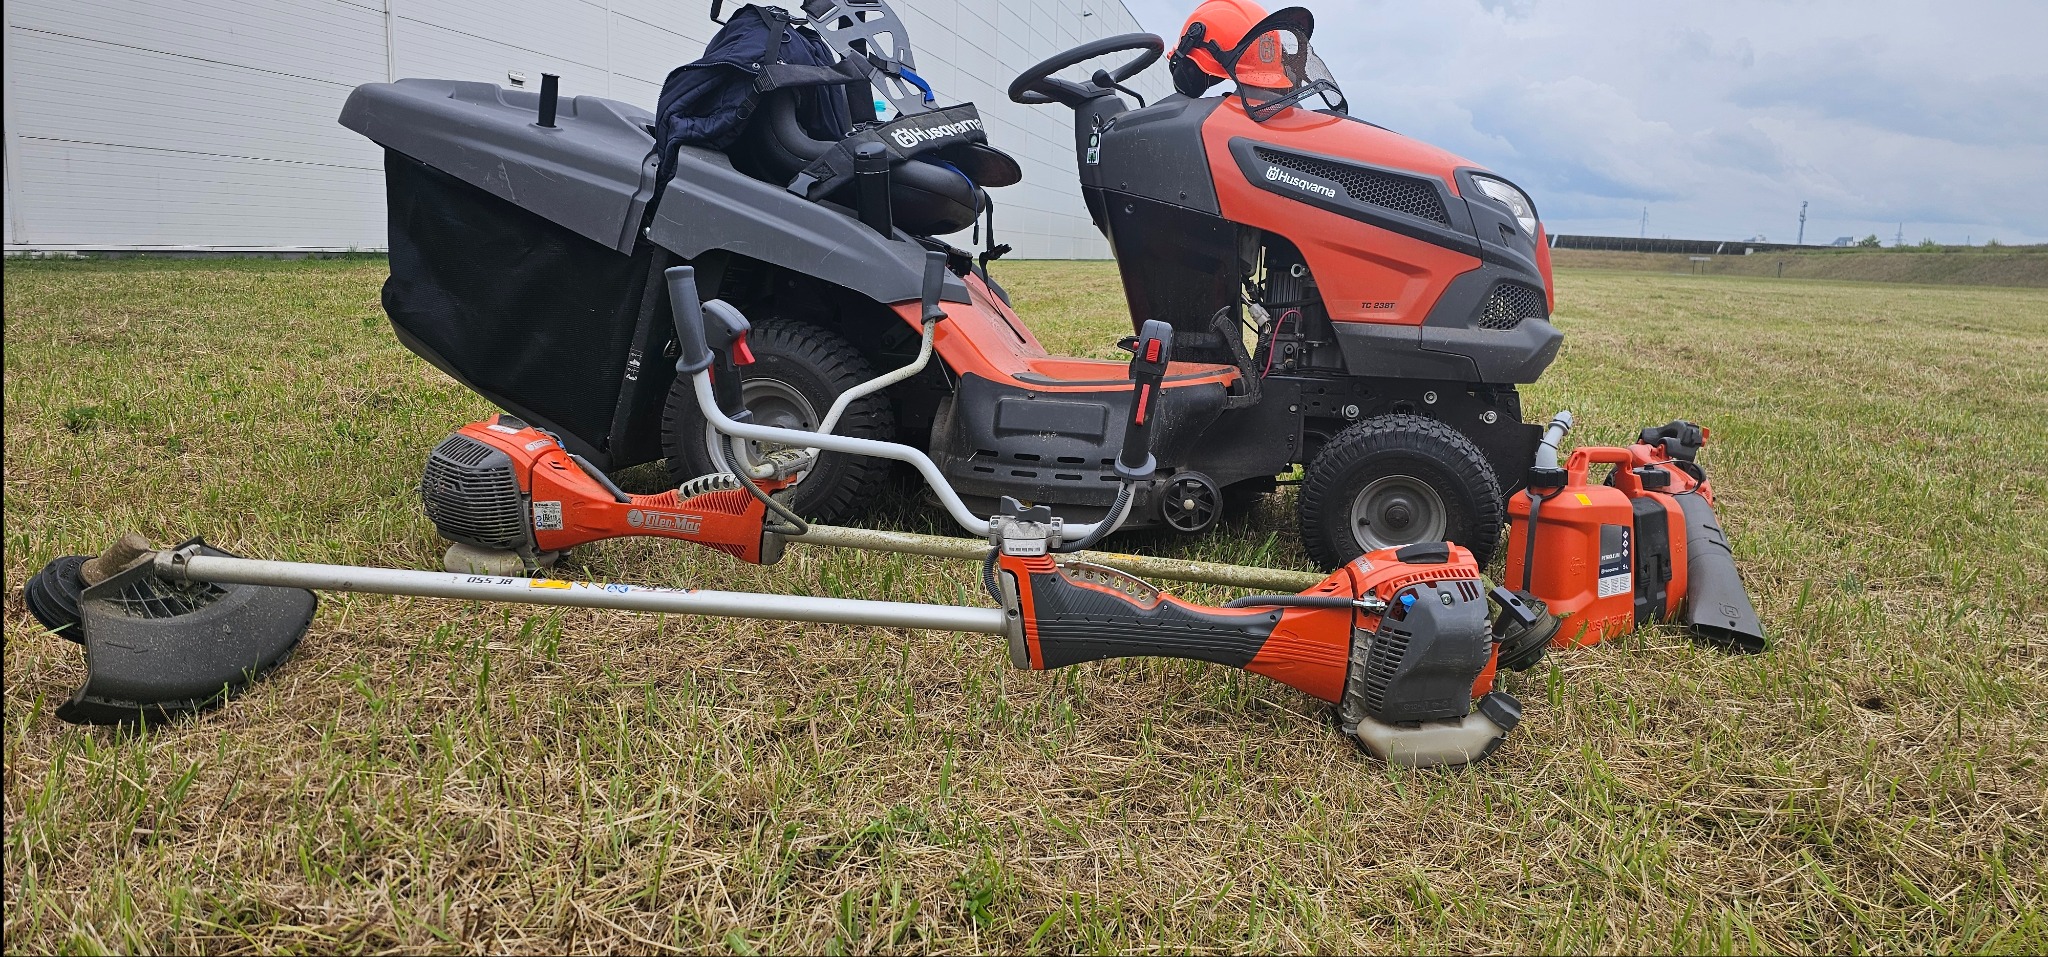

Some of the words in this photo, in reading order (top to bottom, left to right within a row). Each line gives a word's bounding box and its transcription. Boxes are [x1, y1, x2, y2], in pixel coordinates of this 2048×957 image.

[911, 118, 984, 142] Husqvarna
[1278, 171, 1336, 198] Husqvarna
[645, 514, 701, 532] Oleo-Mac
[467, 576, 494, 584] 550
